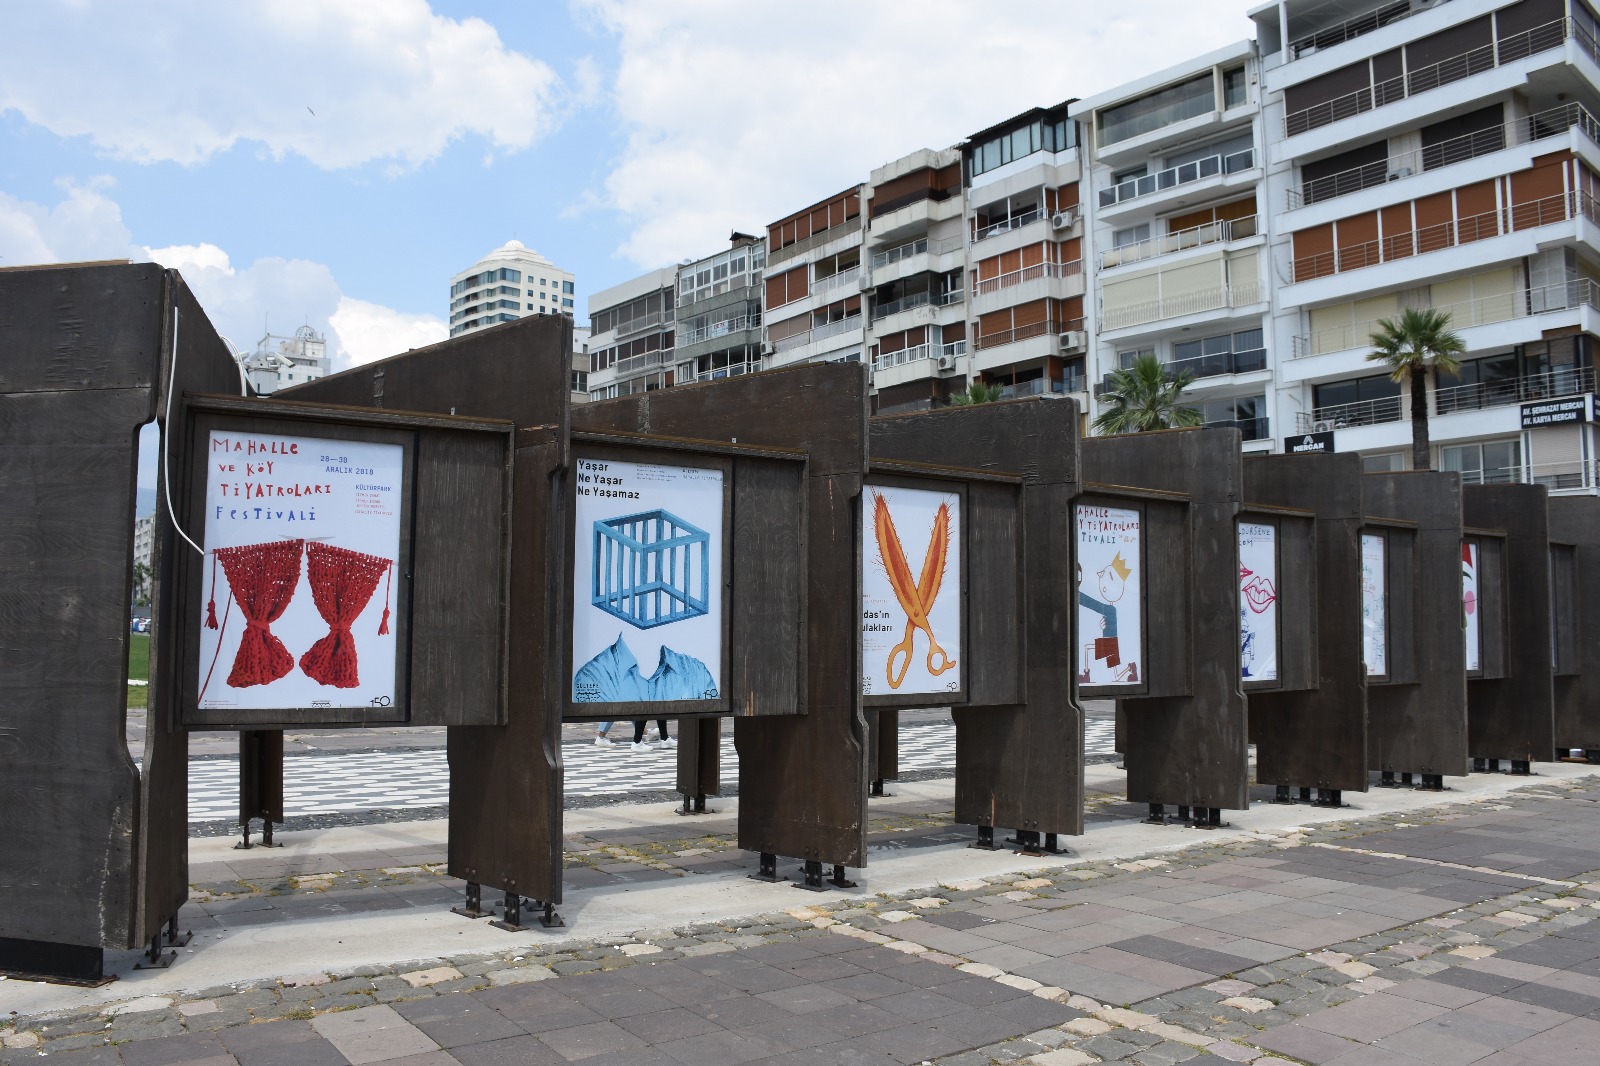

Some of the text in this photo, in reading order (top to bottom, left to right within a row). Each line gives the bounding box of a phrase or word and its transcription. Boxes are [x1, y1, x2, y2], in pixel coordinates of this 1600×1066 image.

[1532, 404, 1559, 416] ŞEHRAZAT
[1560, 401, 1584, 411] MERCAN
[1533, 415, 1551, 424] KARYA
[1552, 412, 1576, 422] MERCAN
[1293, 442, 1324, 452] MERCAN
[218, 461, 274, 476] VE KÖY
[325, 466, 353, 474] ARALIK
[578, 460, 609, 472] Yaşar
[578, 473, 623, 486] Ne Yaşar
[577, 486, 640, 499] Ne Yaşamaz
[863, 610, 889, 619] das'ın
